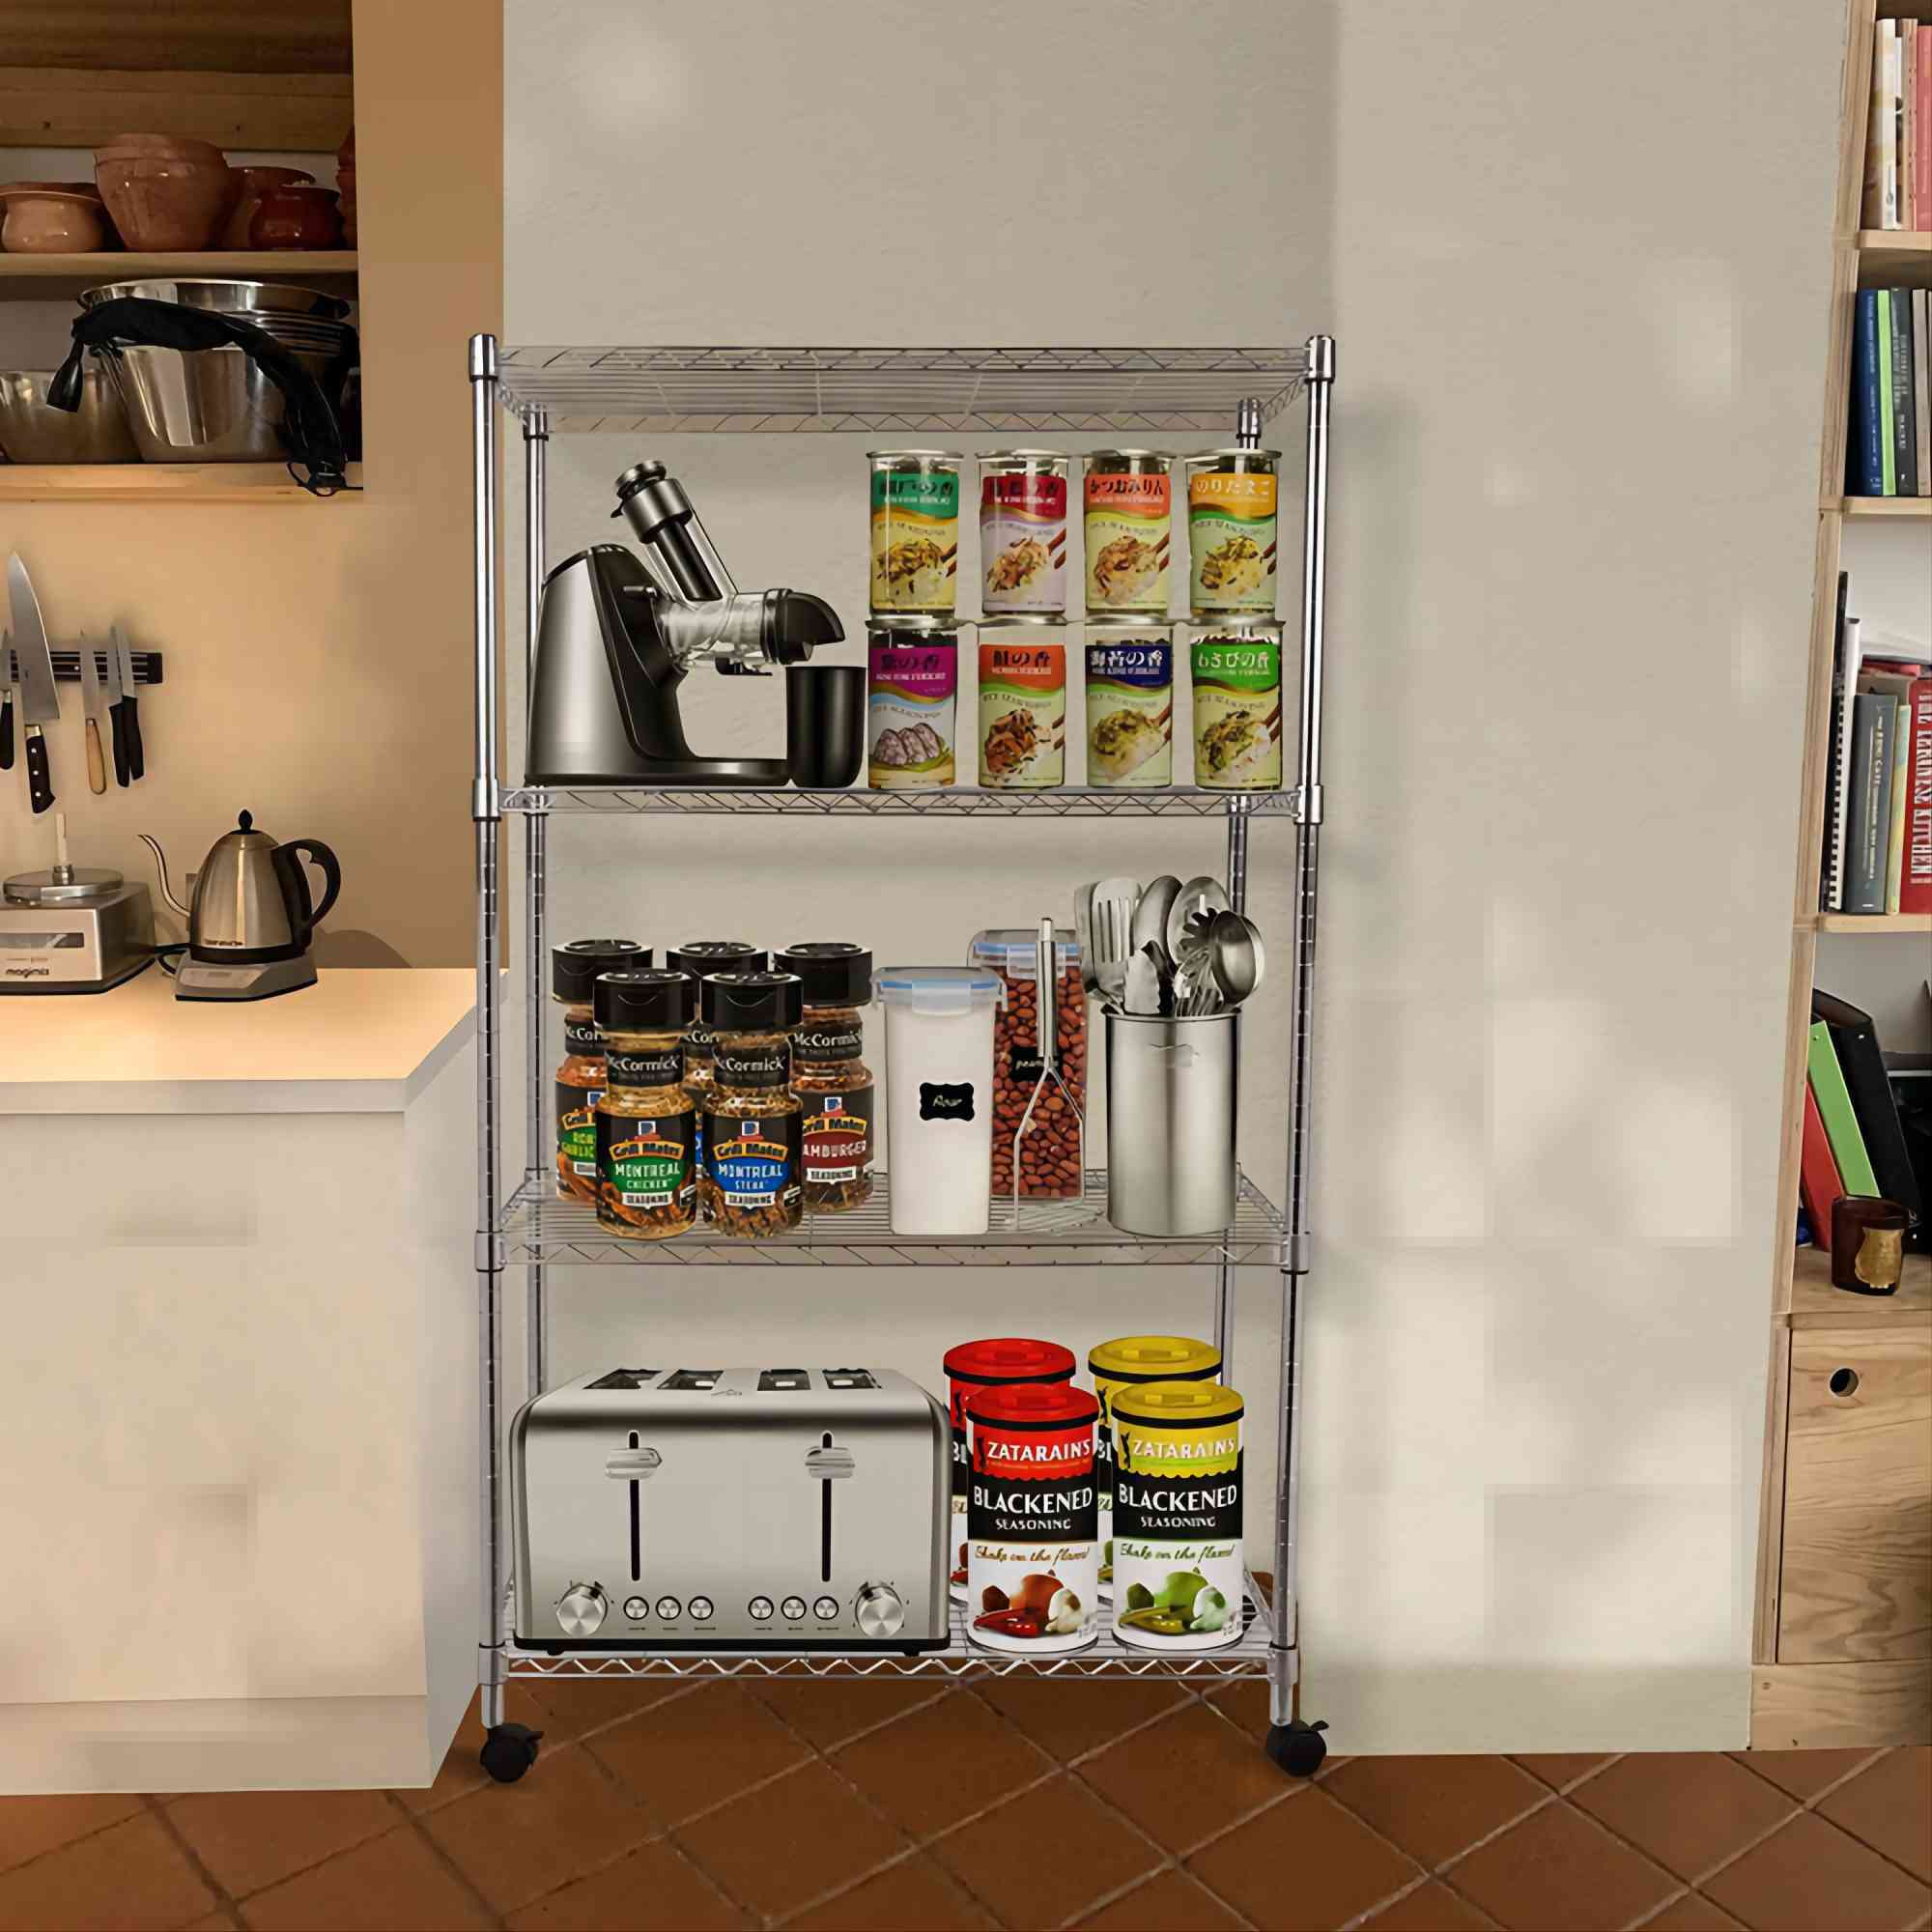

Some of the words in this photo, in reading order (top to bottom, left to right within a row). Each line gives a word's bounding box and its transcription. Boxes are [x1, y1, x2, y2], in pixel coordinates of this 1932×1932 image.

[803, 1140, 867, 1158] AMBURGER
[988, 1439, 1091, 1462] ZATARAINS
[1133, 1437, 1236, 1460] ZATARAINS
[974, 1486, 1093, 1515] BLACKENED
[1119, 1483, 1237, 1512] BLACKENED
[995, 1519, 1071, 1530] SEASONING
[1141, 1516, 1216, 1527] SEASONING
[1175, 1547, 1196, 1559] the
